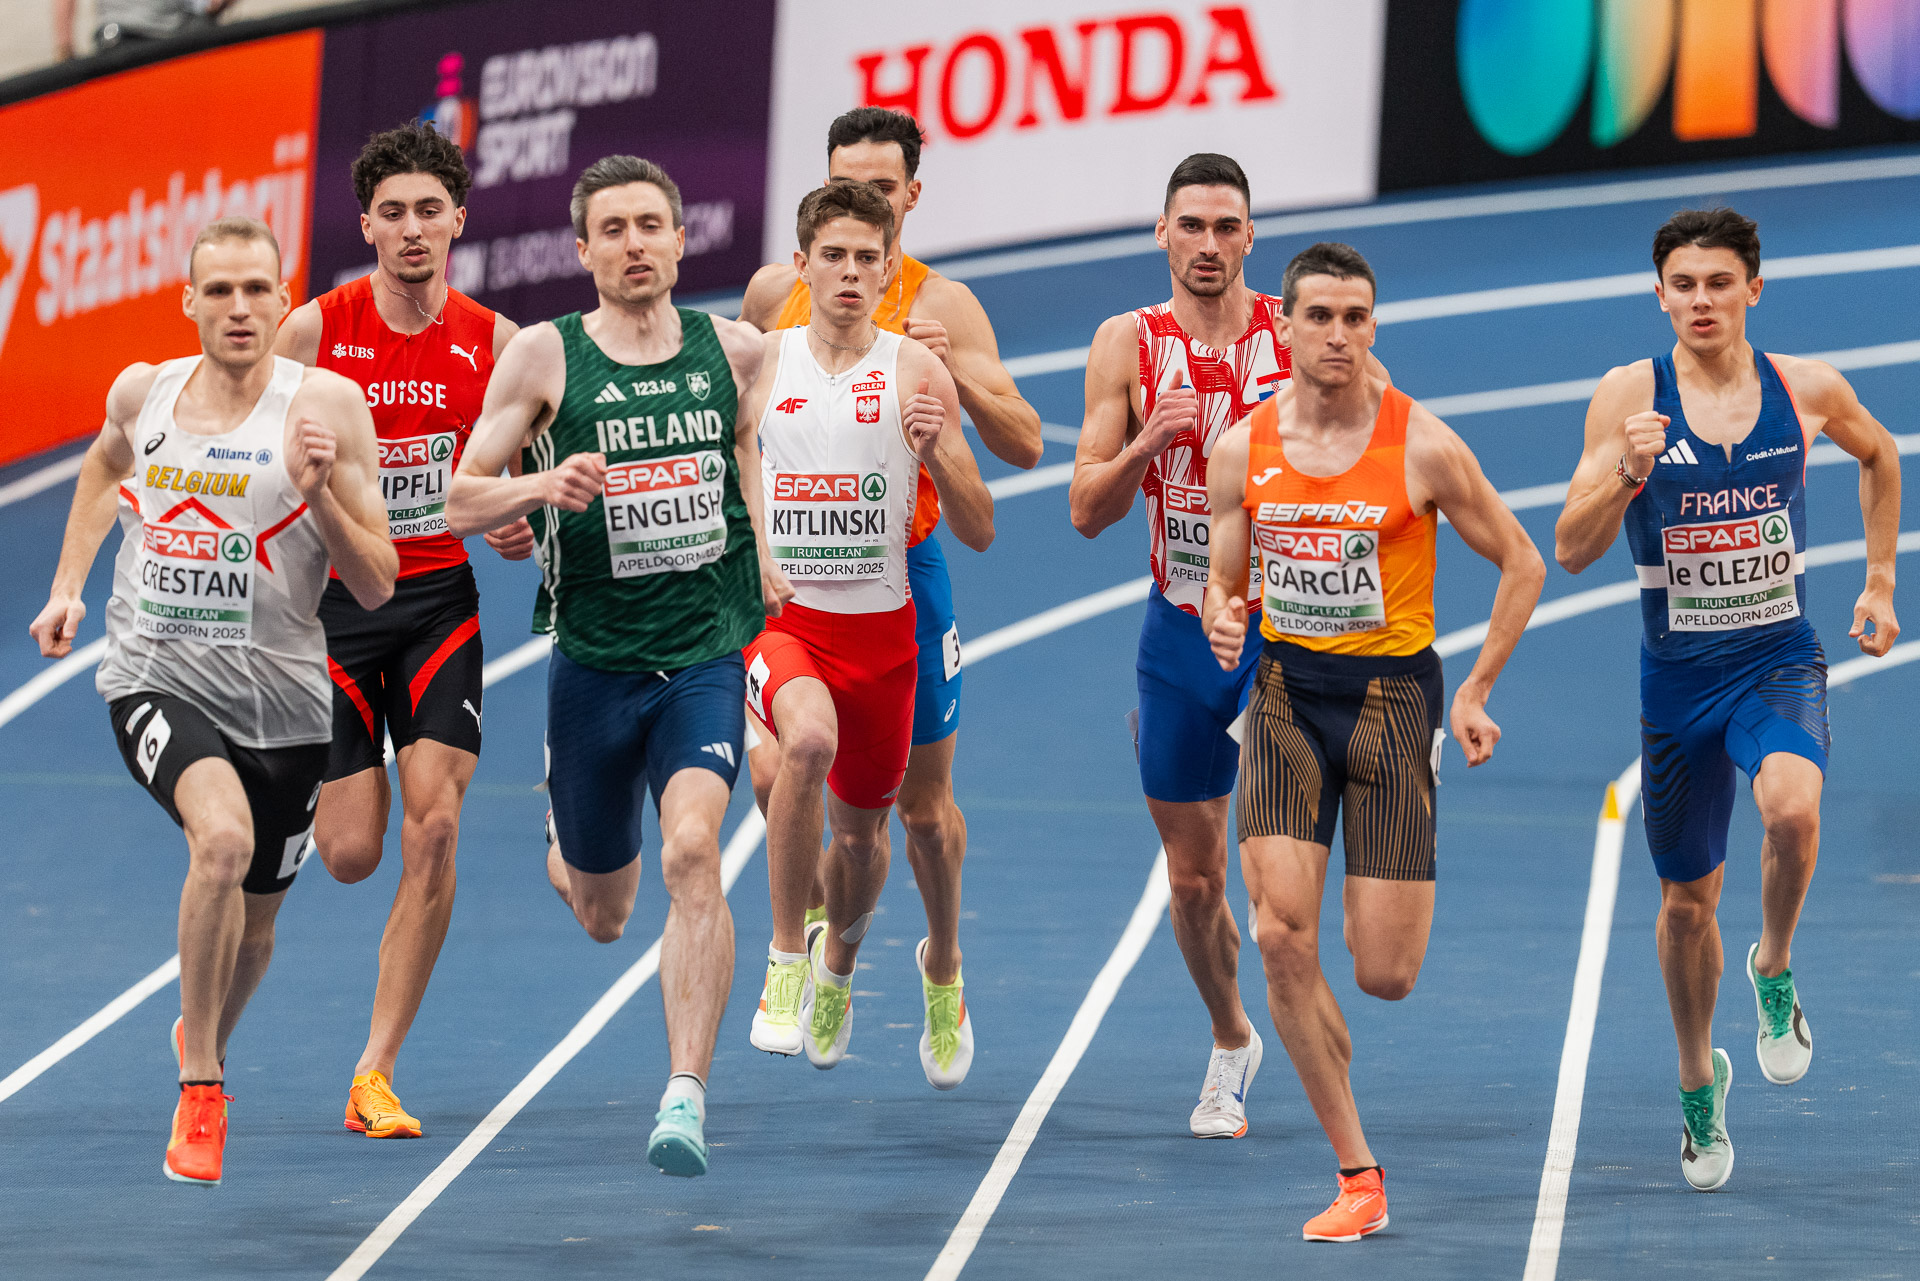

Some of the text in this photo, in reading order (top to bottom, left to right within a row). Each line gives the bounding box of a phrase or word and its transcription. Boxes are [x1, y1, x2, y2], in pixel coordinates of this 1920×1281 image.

[857, 7, 1275, 141] HONDA
[475, 109, 576, 189] SPORT
[348, 345, 375, 360] UBS
[632, 380, 677, 397] 123.ie
[853, 382, 884, 392] ORLEN
[776, 398, 808, 414] 4F
[596, 410, 723, 453] IRELAND
[206, 447, 252, 461] Allianz
[378, 443, 427, 465] PAR
[146, 465, 251, 498] BELGIUM
[378, 468, 443, 500] IPFLI
[605, 461, 699, 493] SPAR
[776, 477, 857, 498] SPAR
[609, 489, 721, 532] ENGLISH
[1256, 500, 1388, 525] ESPAÑA
[1680, 484, 1781, 516] FRANCE
[395, 507, 427, 519] CLEAN
[772, 508, 886, 536] KITLINSKI
[143, 526, 217, 557] SPAR
[638, 532, 709, 552] I RUN CLEAN
[1259, 529, 1340, 558] SPAR
[1668, 525, 1758, 550] SPAR
[617, 552, 702, 571] APELDOORN
[792, 547, 862, 557] I RUN CLEAN
[1195, 556, 1209, 566] RU
[142, 560, 248, 598] CRESTAN
[781, 562, 884, 575] PELDOORN 2025
[1267, 560, 1376, 595] GARCÍA
[1667, 550, 1791, 587] le CLEZIO
[152, 604, 175, 617] RUN
[177, 607, 220, 620] CLEAN
[1281, 601, 1350, 617] I RUN CLEAN
[1695, 592, 1767, 608] I RUN CLEAN
[1675, 601, 1794, 626] APELDOORN 2025
[136, 616, 246, 640] APELDOORN 2025
[953, 631, 961, 668] 3
[750, 672, 760, 701] 4
[145, 732, 158, 763] 6
